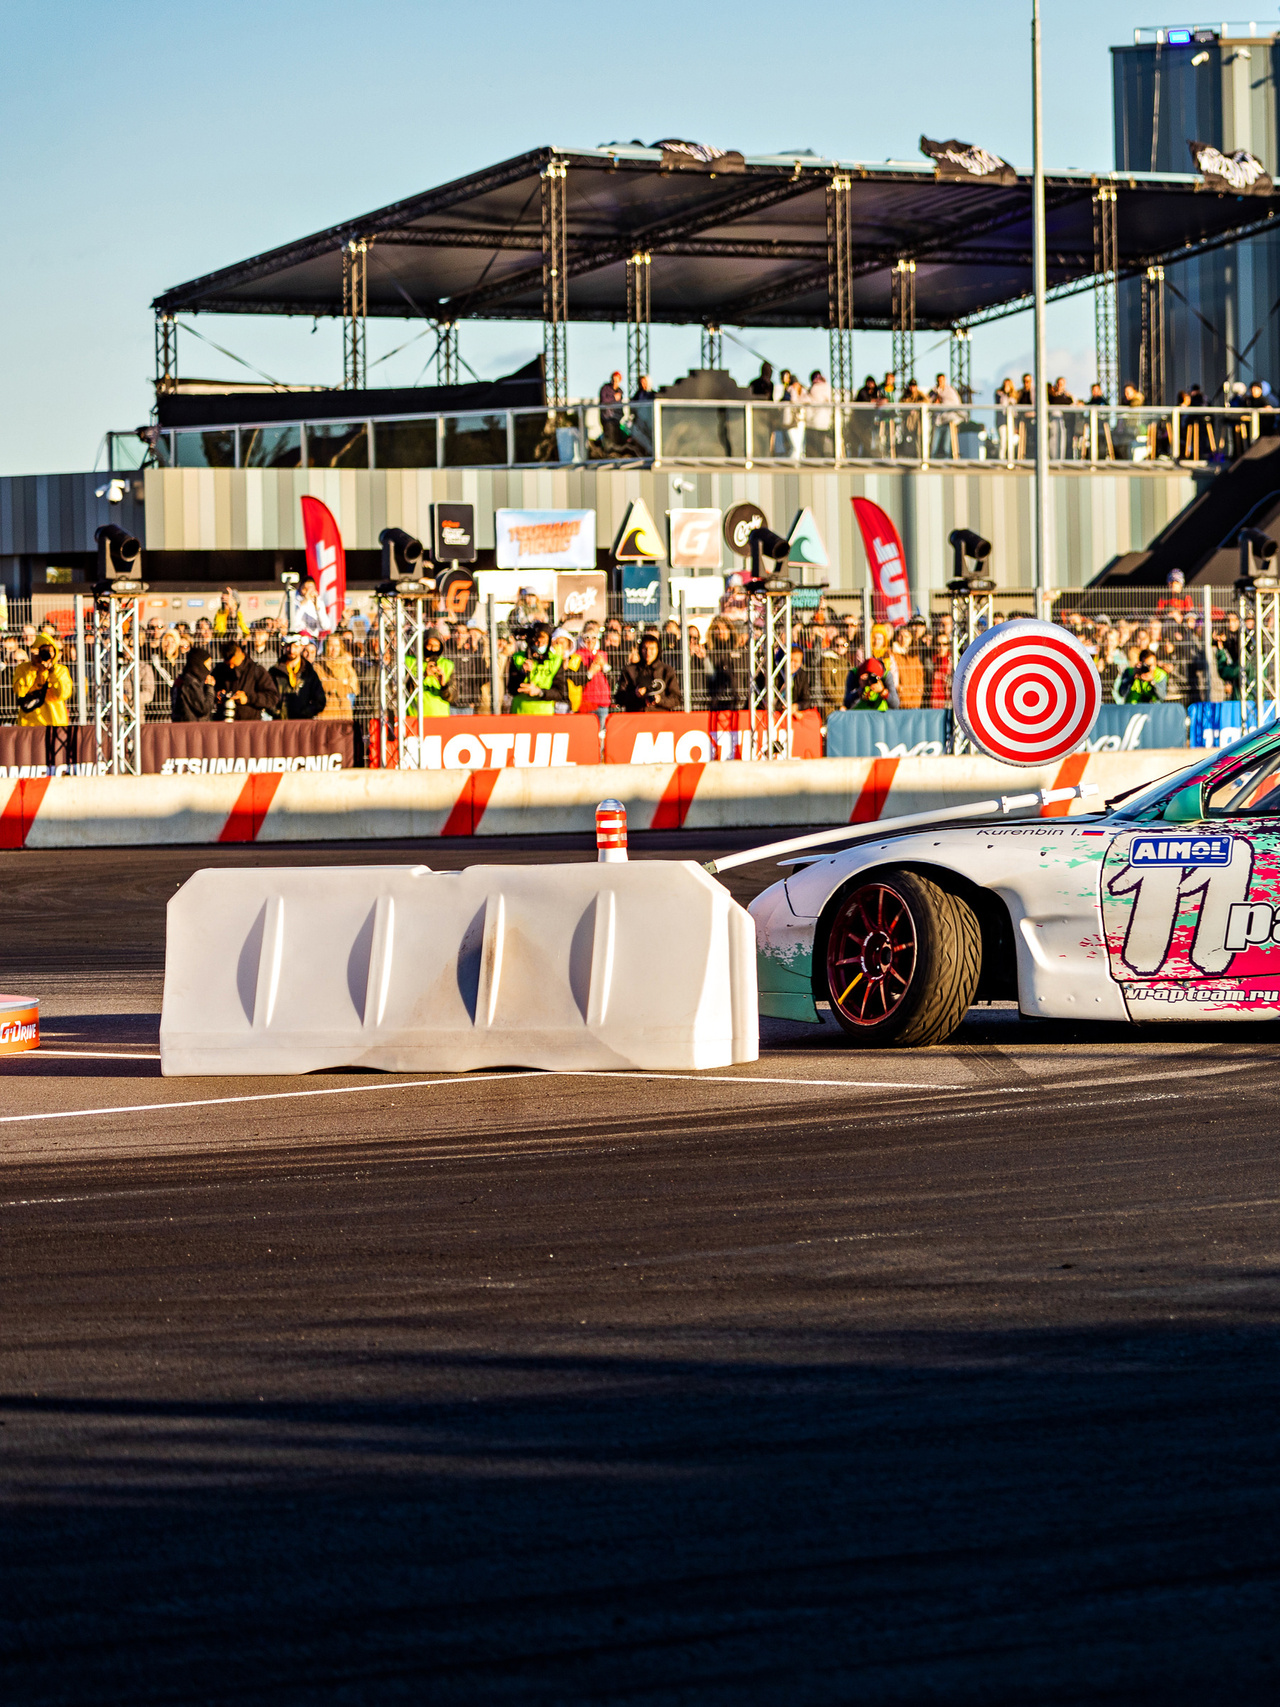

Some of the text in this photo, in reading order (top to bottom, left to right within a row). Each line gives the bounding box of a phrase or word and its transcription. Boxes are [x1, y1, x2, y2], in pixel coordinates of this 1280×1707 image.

[402, 733, 577, 769] MOTUL
[976, 828, 1064, 836] Kurenbin
[1133, 841, 1227, 860] AIMOL
[1125, 987, 1279, 1002] wrapteam.ru
